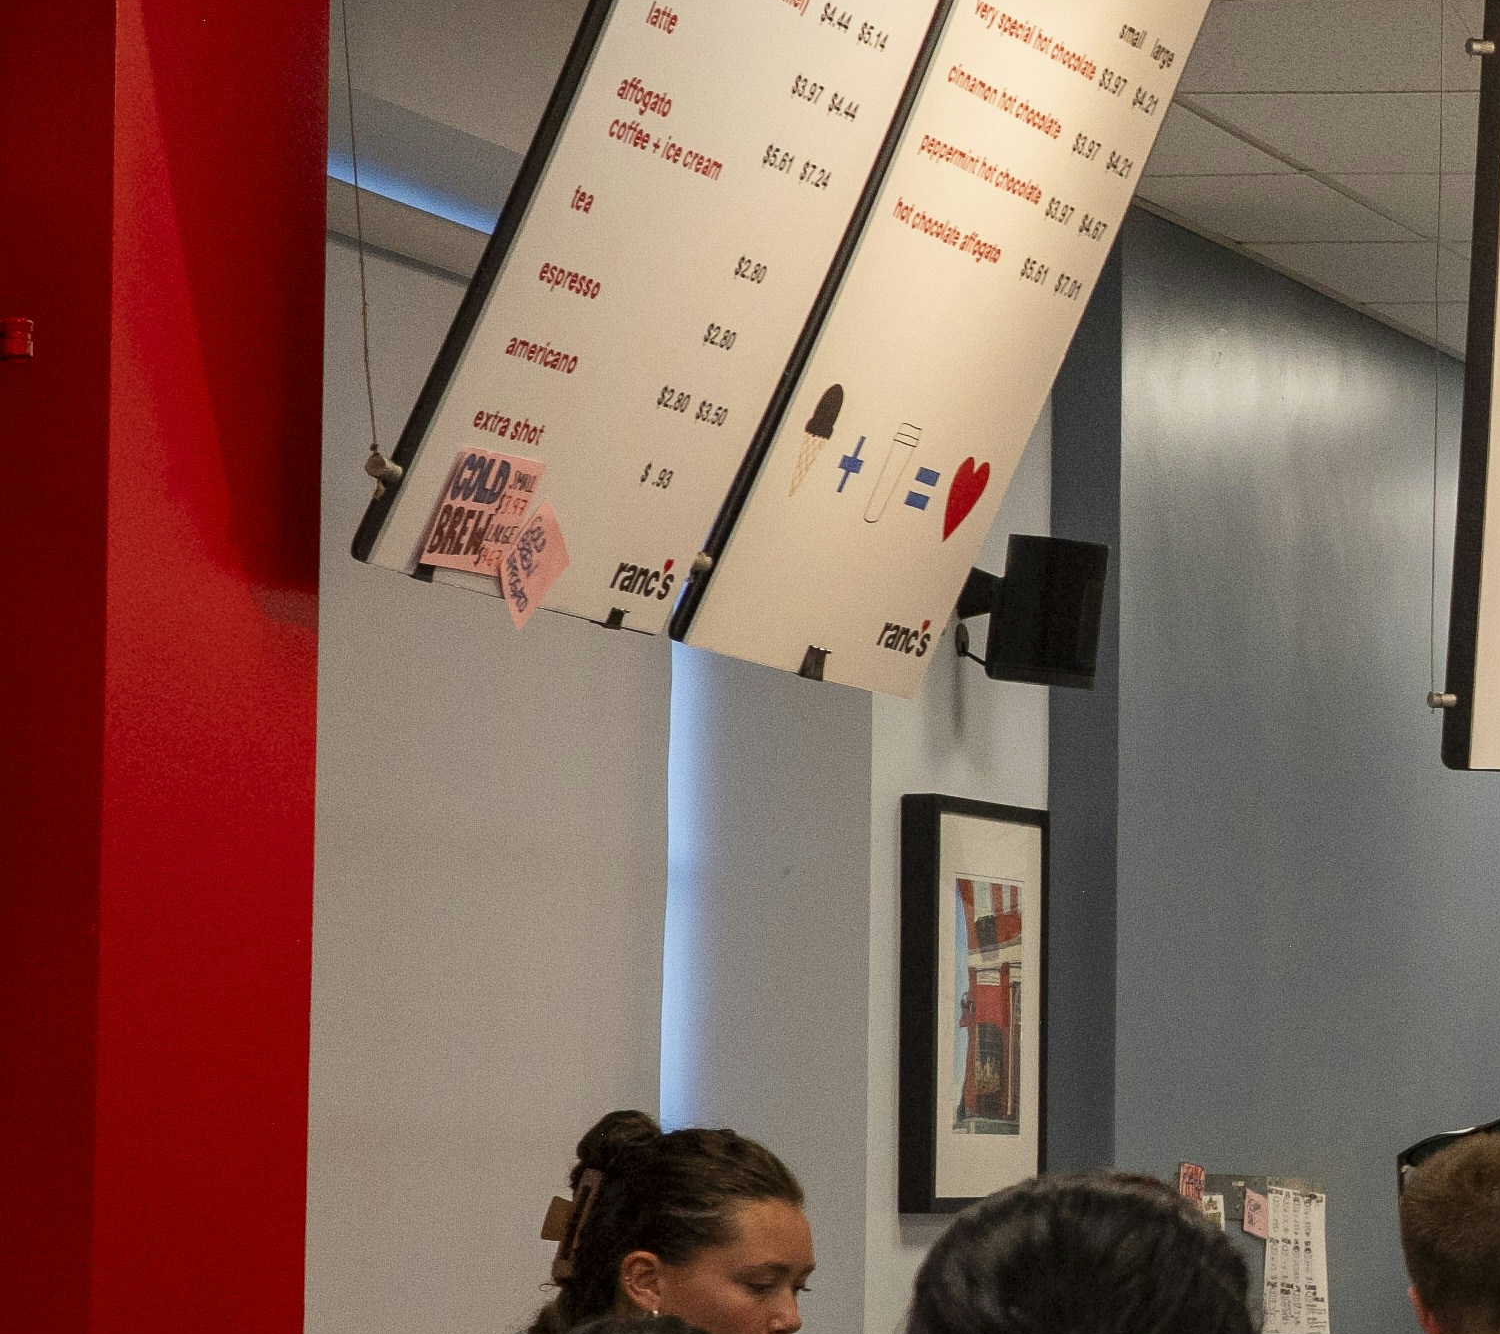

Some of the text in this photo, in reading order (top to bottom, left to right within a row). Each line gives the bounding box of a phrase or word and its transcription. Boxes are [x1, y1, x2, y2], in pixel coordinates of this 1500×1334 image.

[646, 0, 677, 34] latte
[571, 185, 594, 214] tea
[539, 262, 601, 299] espresso
[506, 336, 578, 374] americano
[473, 408, 545, 445] extra shot
[451, 454, 510, 504] COLD
[427, 504, 495, 555] BREW
